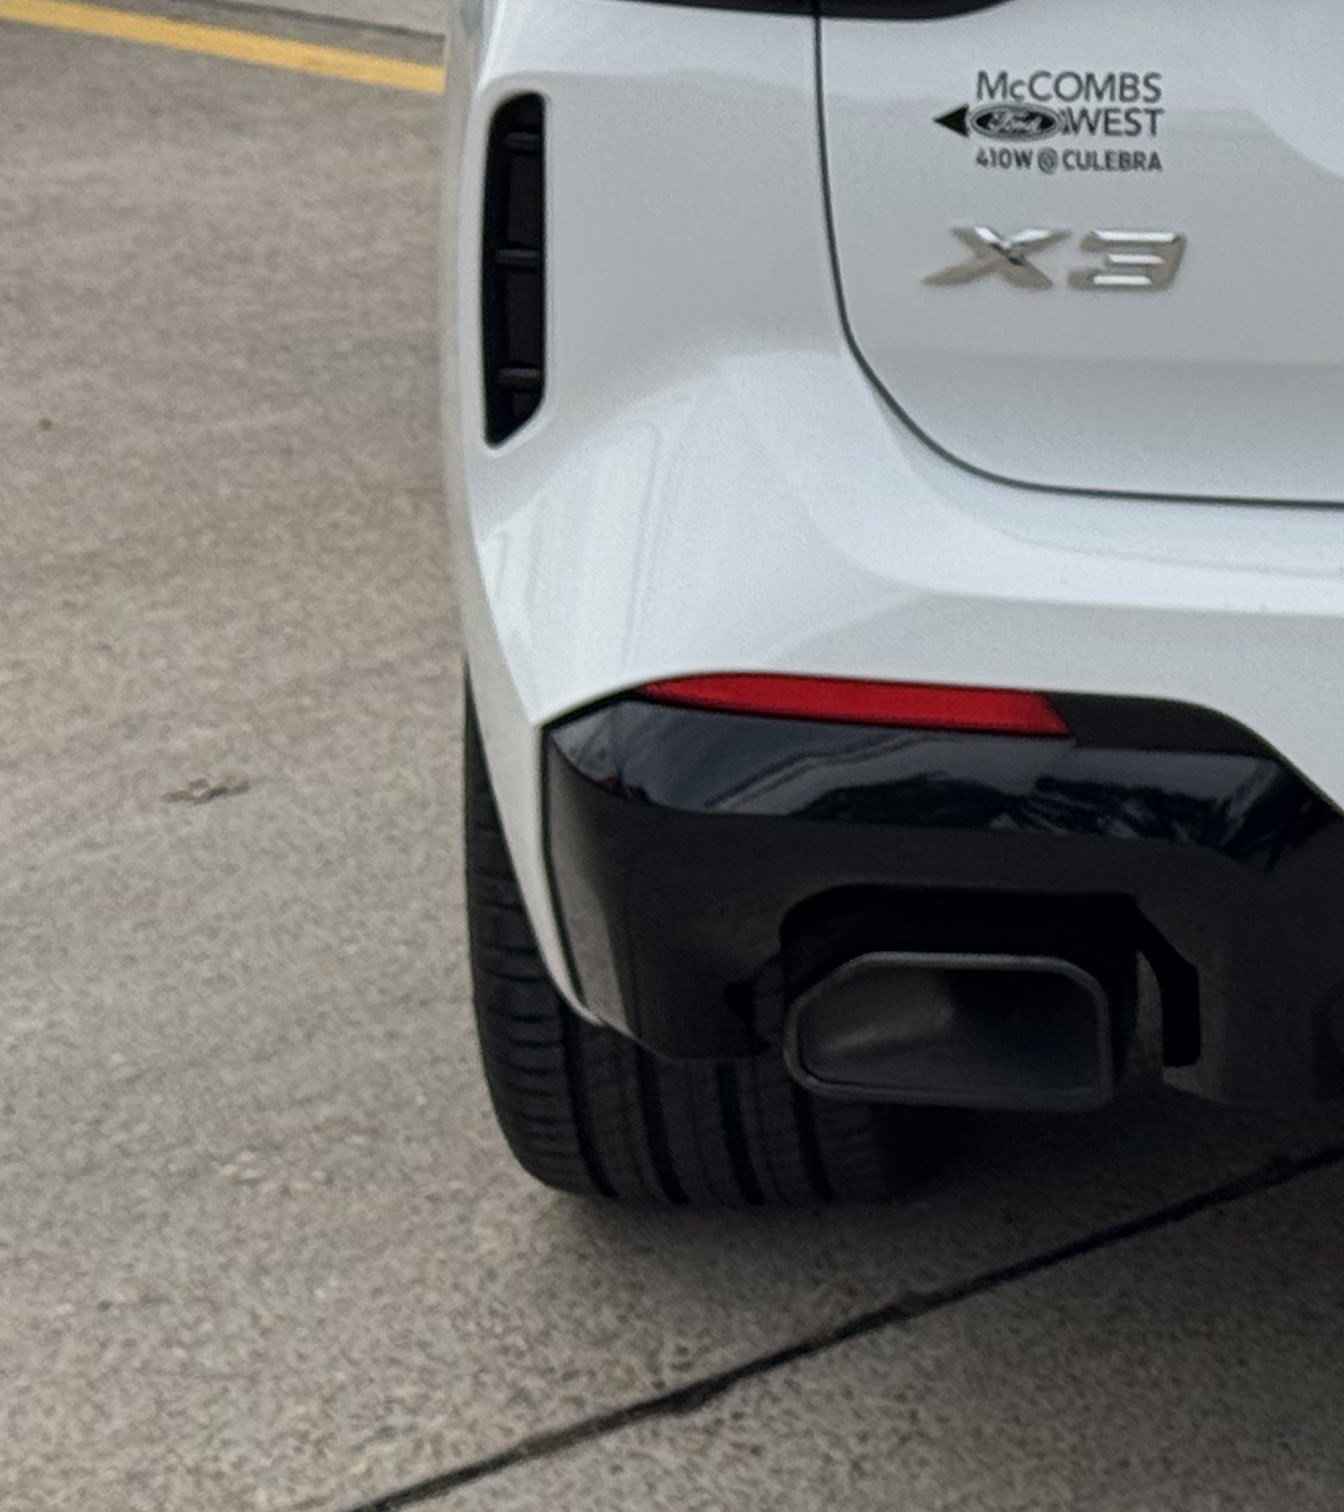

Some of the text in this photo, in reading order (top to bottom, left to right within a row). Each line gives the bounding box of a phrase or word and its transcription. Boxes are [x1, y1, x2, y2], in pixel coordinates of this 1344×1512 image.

[975, 69, 1163, 103] McCOMBS
[1062, 105, 1165, 137] WEST
[920, 224, 1187, 291] X3
